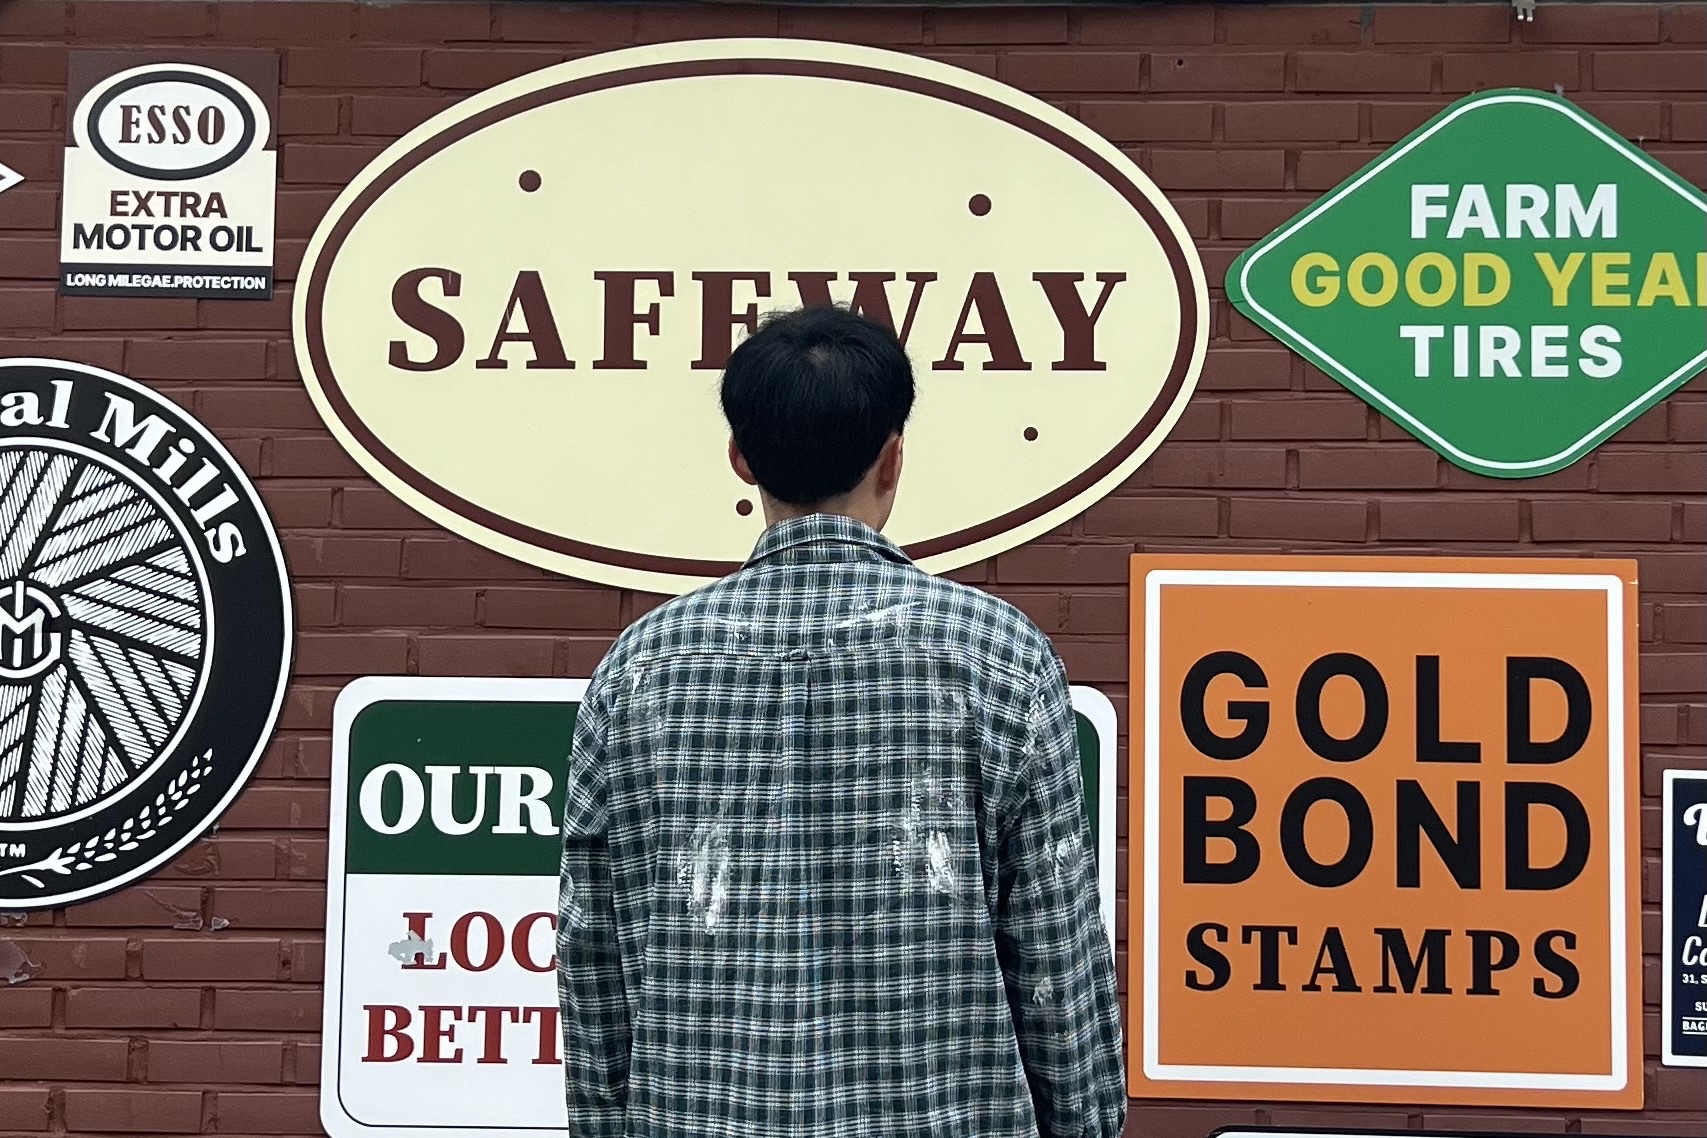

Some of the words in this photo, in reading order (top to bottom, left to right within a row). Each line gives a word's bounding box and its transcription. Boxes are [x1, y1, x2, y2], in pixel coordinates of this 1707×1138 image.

[118, 104, 226, 146] ESSO
[109, 190, 228, 219] EXTRA
[1410, 183, 1618, 239] FARM
[73, 223, 202, 252] MOTOR
[209, 225, 264, 253] OIL
[66, 273, 107, 287] LONG
[1290, 251, 1511, 308] GOOD
[1534, 251, 1707, 307] YEA
[1399, 324, 1623, 378] TIRES
[89, 391, 248, 564] Mills
[1180, 651, 1592, 765] GOLD
[359, 763, 560, 835] OUR
[1183, 775, 1591, 891] BOND
[1185, 922, 1581, 999] STAMPS
[1682, 1020, 1707, 1032] BAG
